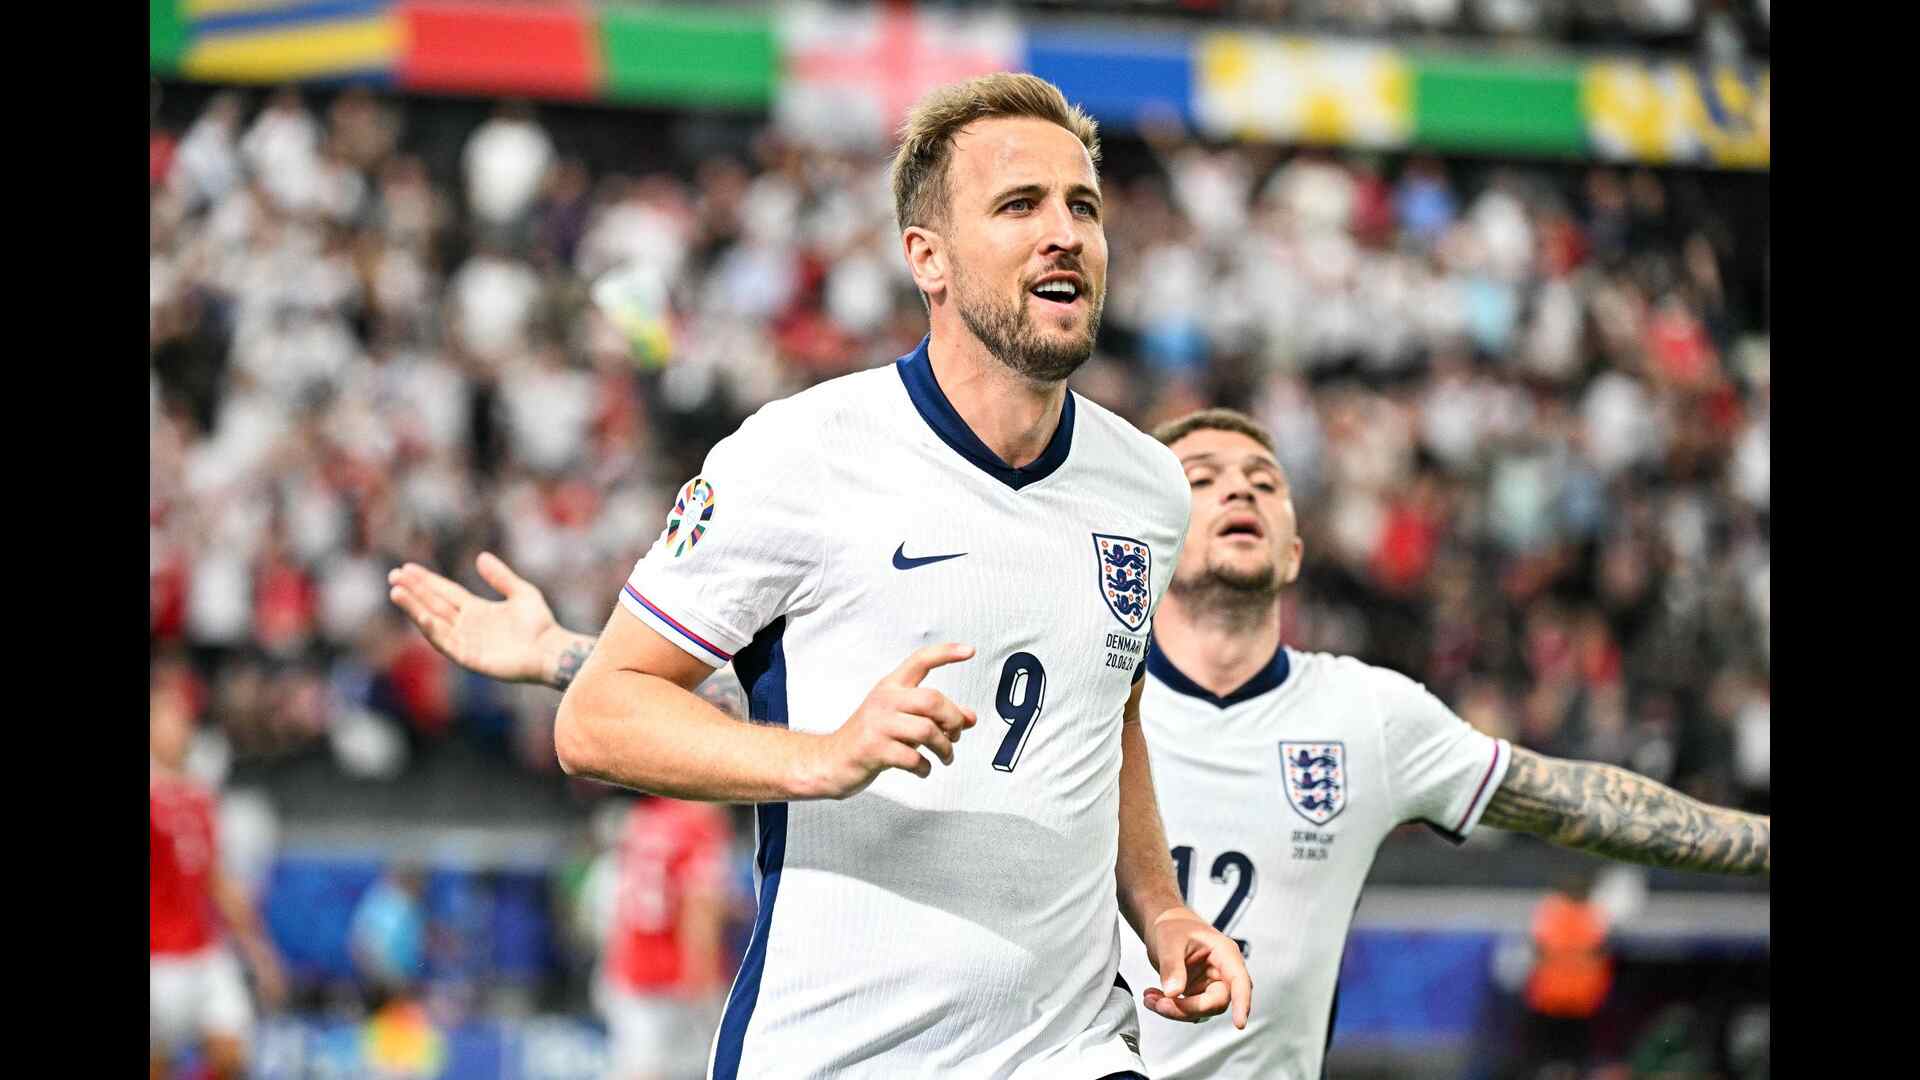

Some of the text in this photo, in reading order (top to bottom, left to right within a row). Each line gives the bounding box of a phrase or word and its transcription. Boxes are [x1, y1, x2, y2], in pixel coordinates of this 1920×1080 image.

[1105, 633, 1142, 655] DENMAR
[992, 651, 1047, 773] 9
[1171, 845, 1257, 959] 12
